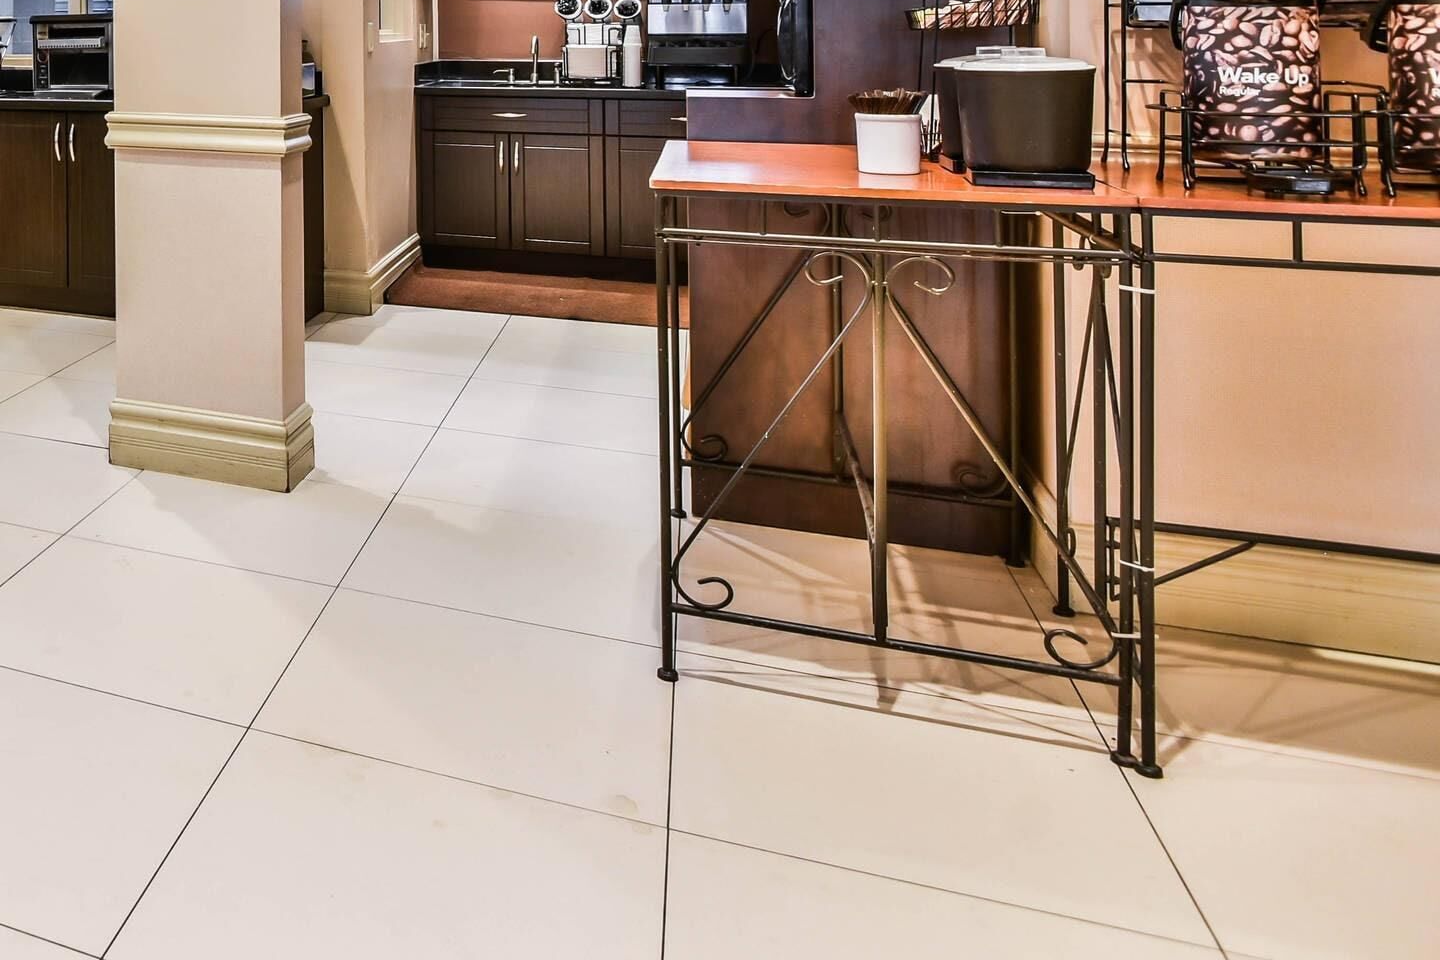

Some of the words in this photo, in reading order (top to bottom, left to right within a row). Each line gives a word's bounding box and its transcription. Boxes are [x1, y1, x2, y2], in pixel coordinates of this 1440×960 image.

[1217, 66, 1280, 84] Wake
[1285, 67, 1309, 87] Up
[1220, 86, 1261, 96] Regular
